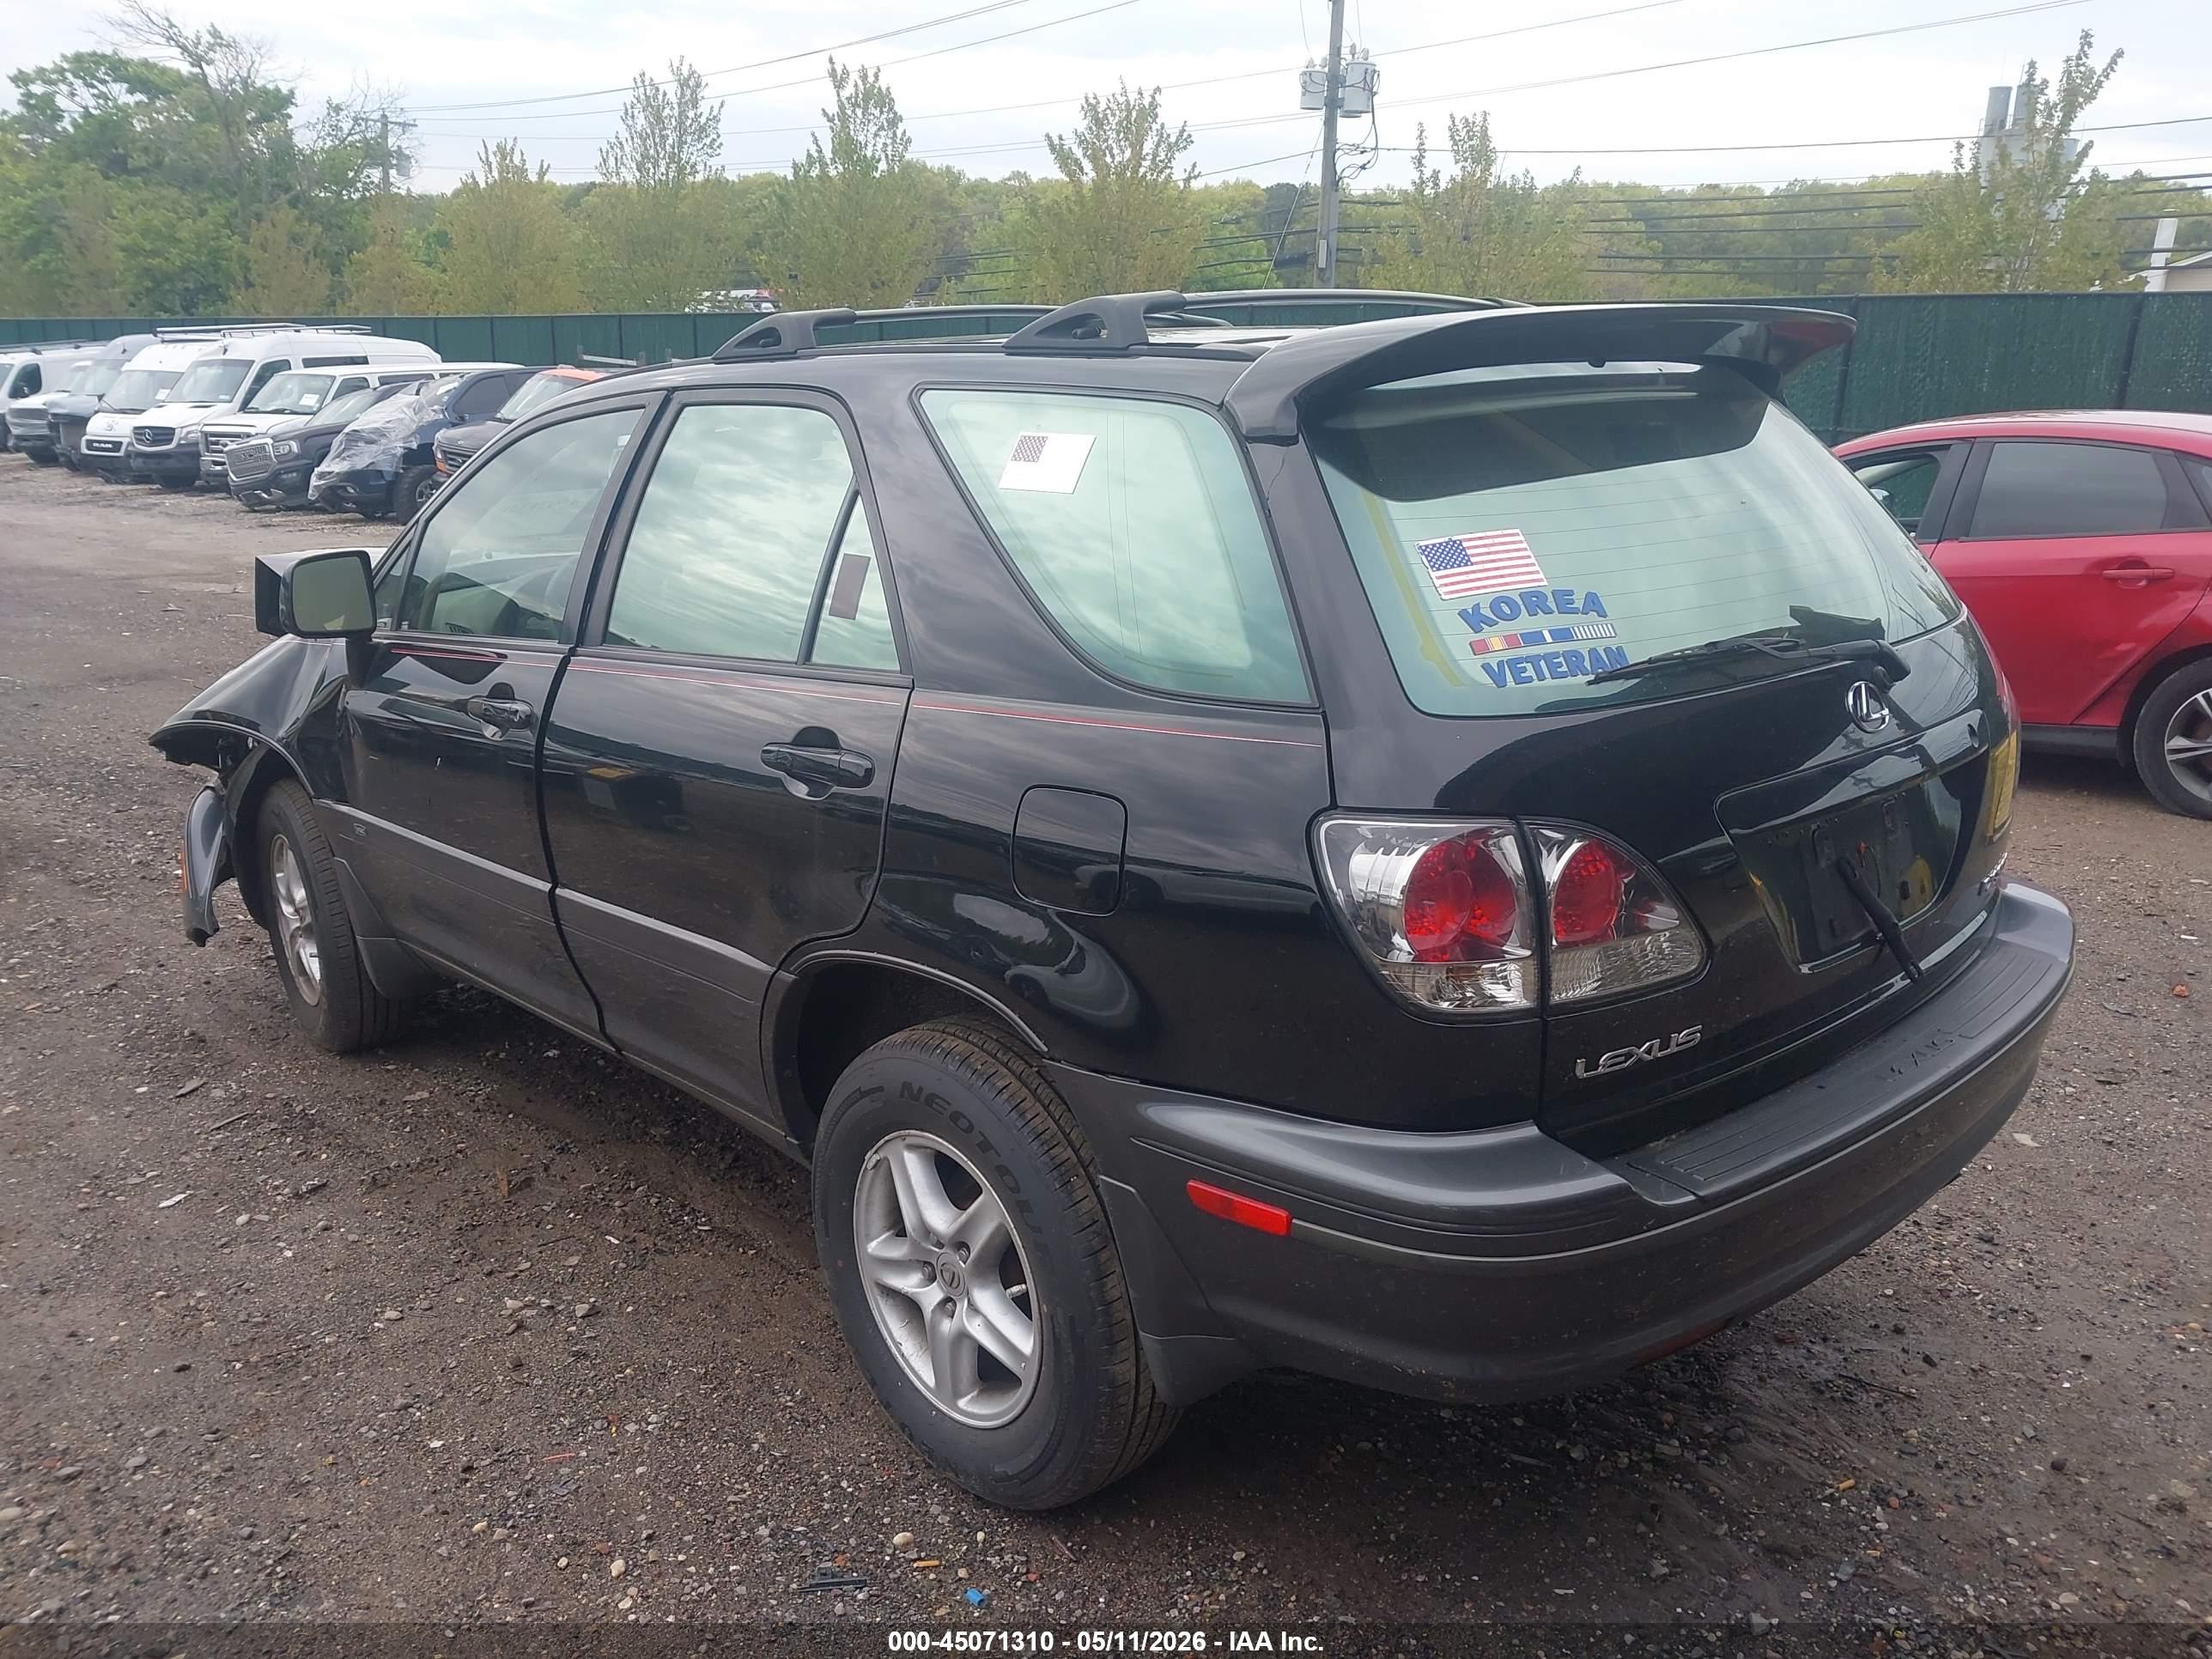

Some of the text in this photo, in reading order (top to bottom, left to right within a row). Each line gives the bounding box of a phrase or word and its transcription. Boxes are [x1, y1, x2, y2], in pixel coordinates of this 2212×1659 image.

[1457, 589, 1608, 634] KOREA
[1481, 646, 1631, 689] VETERAN
[1575, 1024, 1703, 1079] LEXUS
